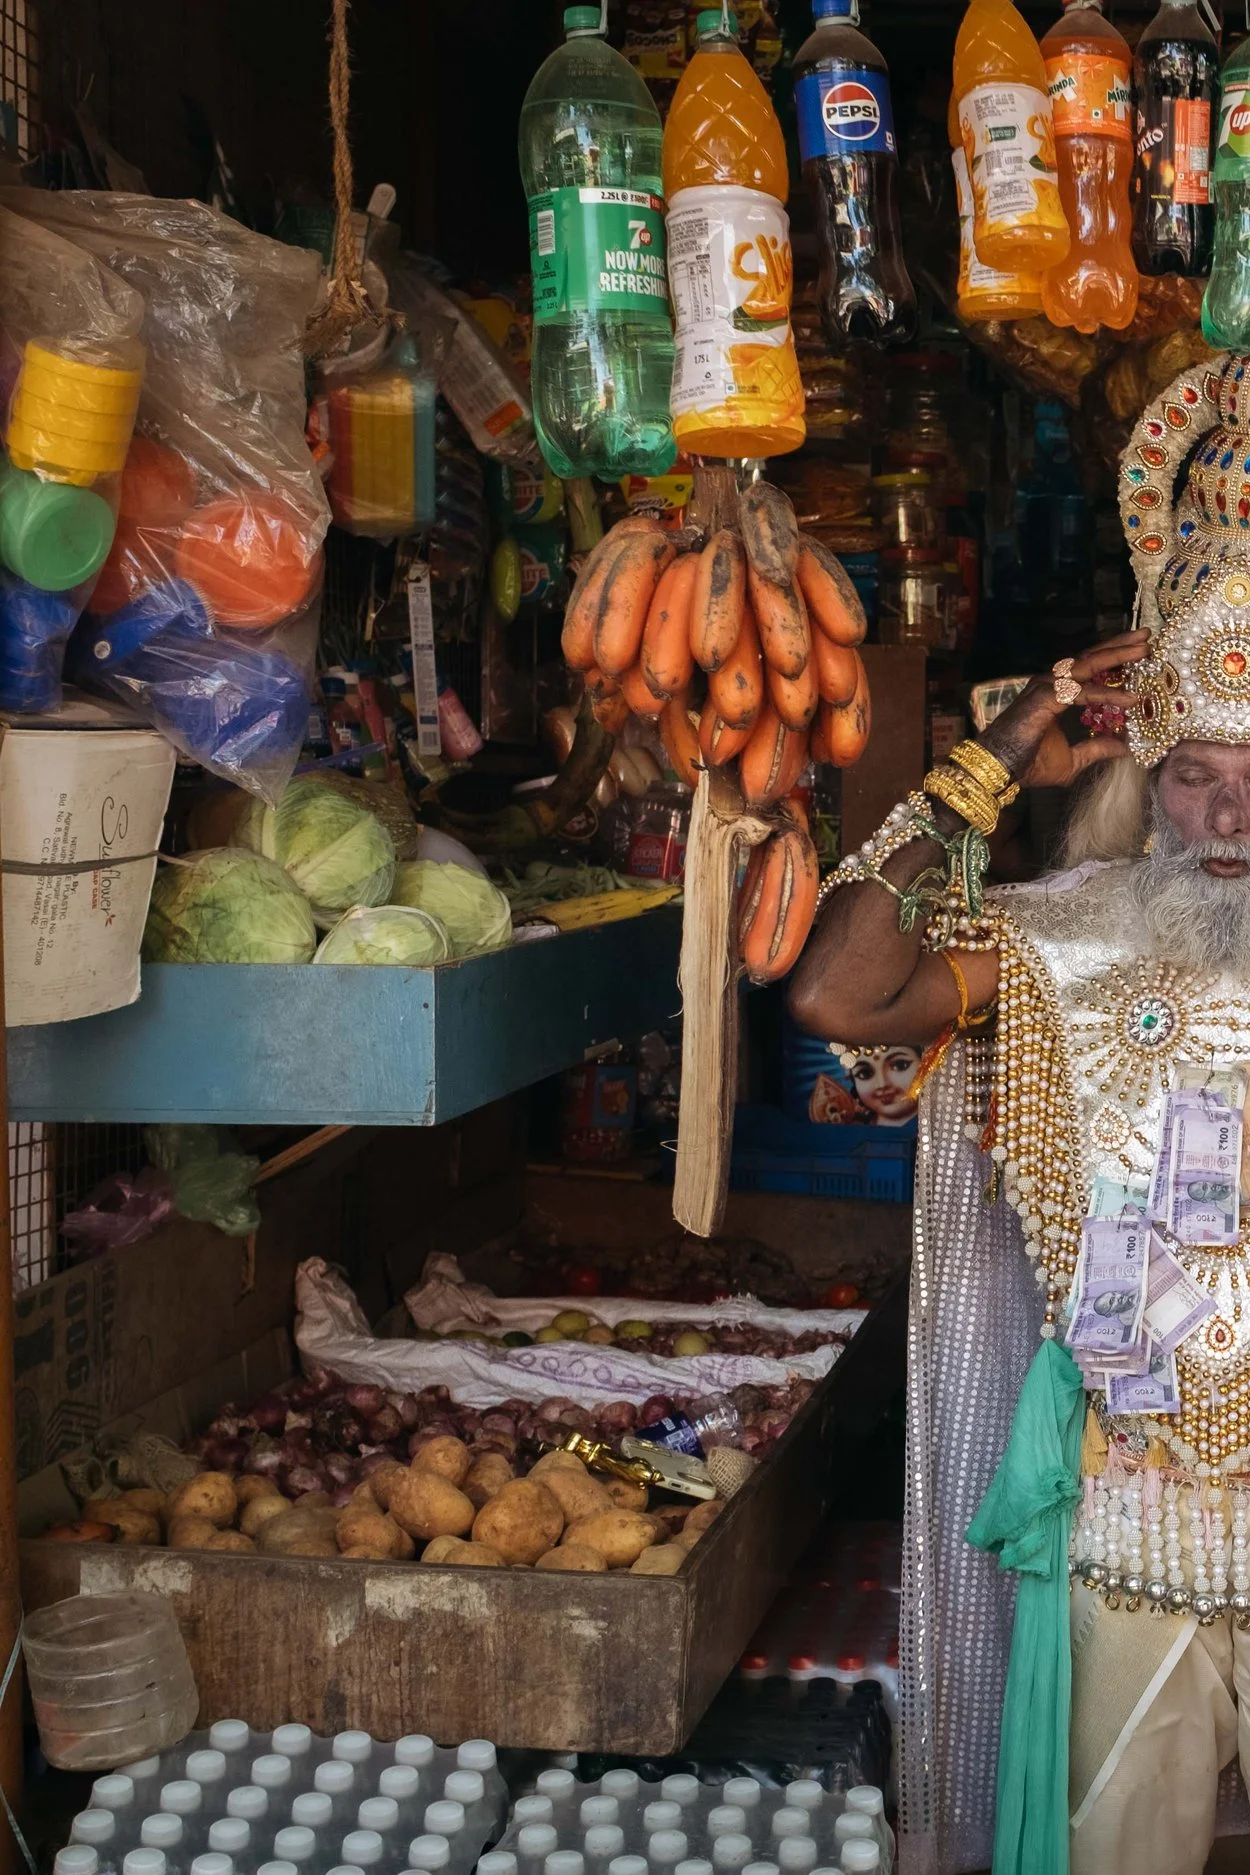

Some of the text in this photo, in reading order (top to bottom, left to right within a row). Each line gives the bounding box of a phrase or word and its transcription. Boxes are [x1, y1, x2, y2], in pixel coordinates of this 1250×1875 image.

[1049, 76, 1076, 96] RINDA
[825, 103, 877, 120] PEPSI
[605, 250, 638, 271] NOW
[600, 271, 668, 300] REFRESHIN
[100, 796, 129, 916] Suflower
[1218, 1127, 1229, 1151] ₹100
[1126, 1236, 1136, 1260] ₹100
